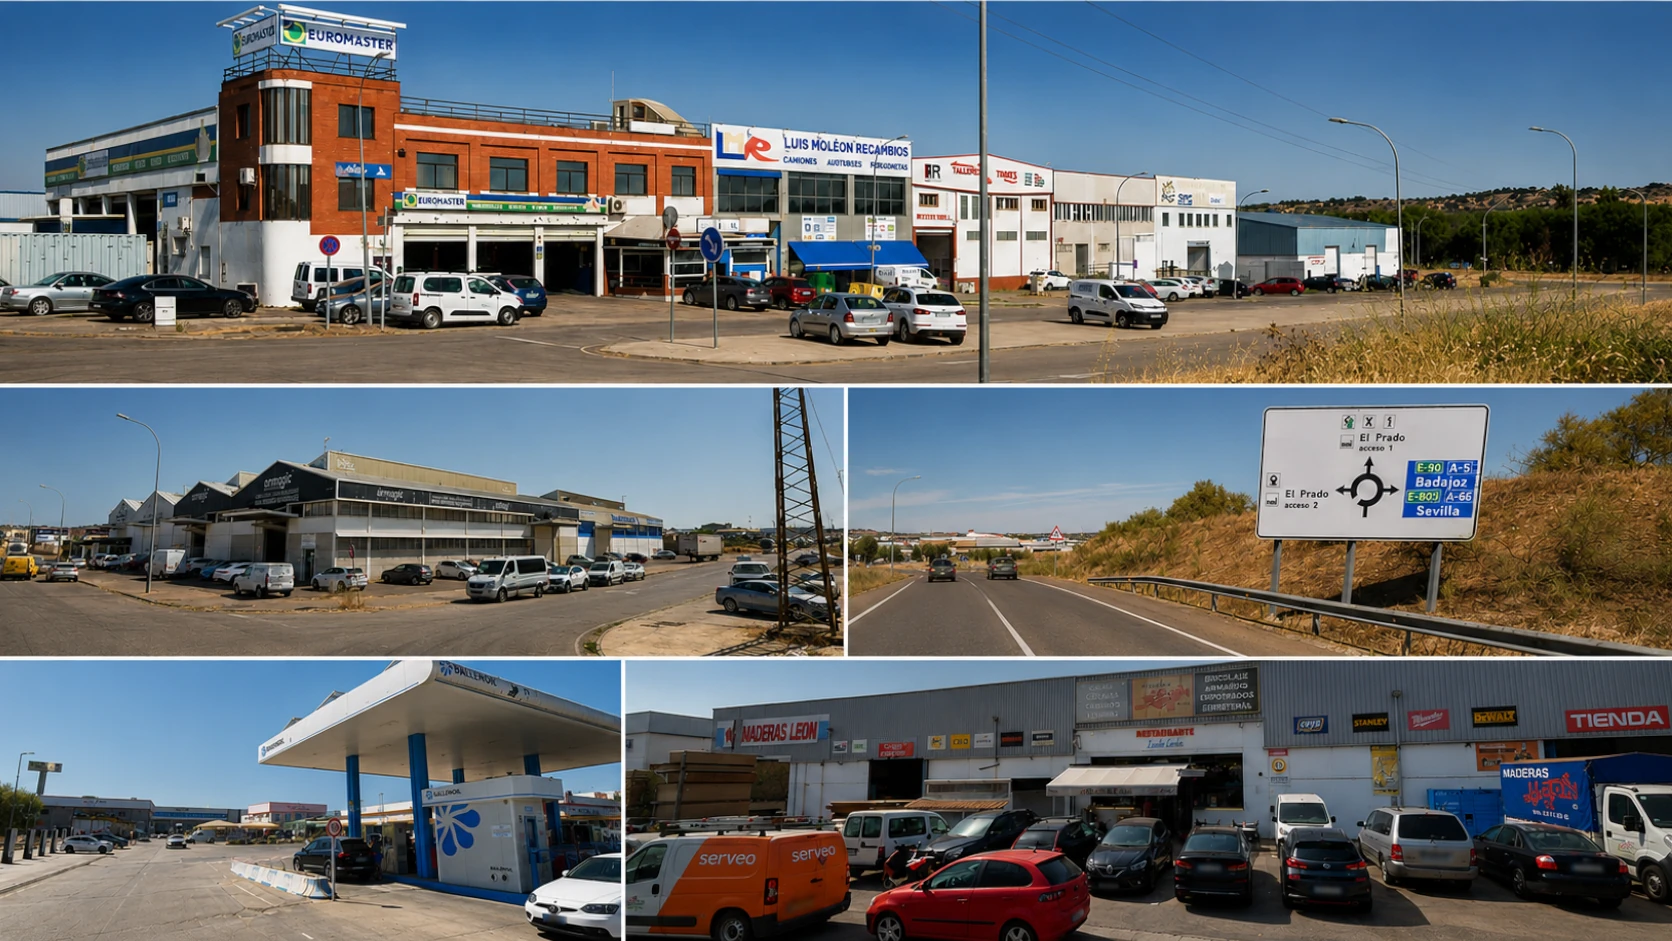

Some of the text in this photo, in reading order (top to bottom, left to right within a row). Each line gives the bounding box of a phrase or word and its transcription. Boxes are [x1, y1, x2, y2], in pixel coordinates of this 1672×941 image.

[308, 28, 393, 51] EUROMASTER
[784, 137, 909, 157] LUIS MOLÉON RECAMBIOS
[1360, 433, 1406, 442] El Prado
[1417, 463, 1471, 472] E-90 A-5
[1415, 476, 1468, 490] Badajoz
[1285, 490, 1329, 498] El Prado
[1446, 492, 1472, 502] A-66
[1416, 505, 1460, 517] Sevilla
[1354, 718, 1388, 728] STANLEY
[1570, 710, 1664, 728] TIENDA
[790, 721, 818, 740] LEON
[1503, 768, 1549, 778] MADERAS
[700, 852, 756, 866] serveo
[792, 845, 836, 863] serveo
